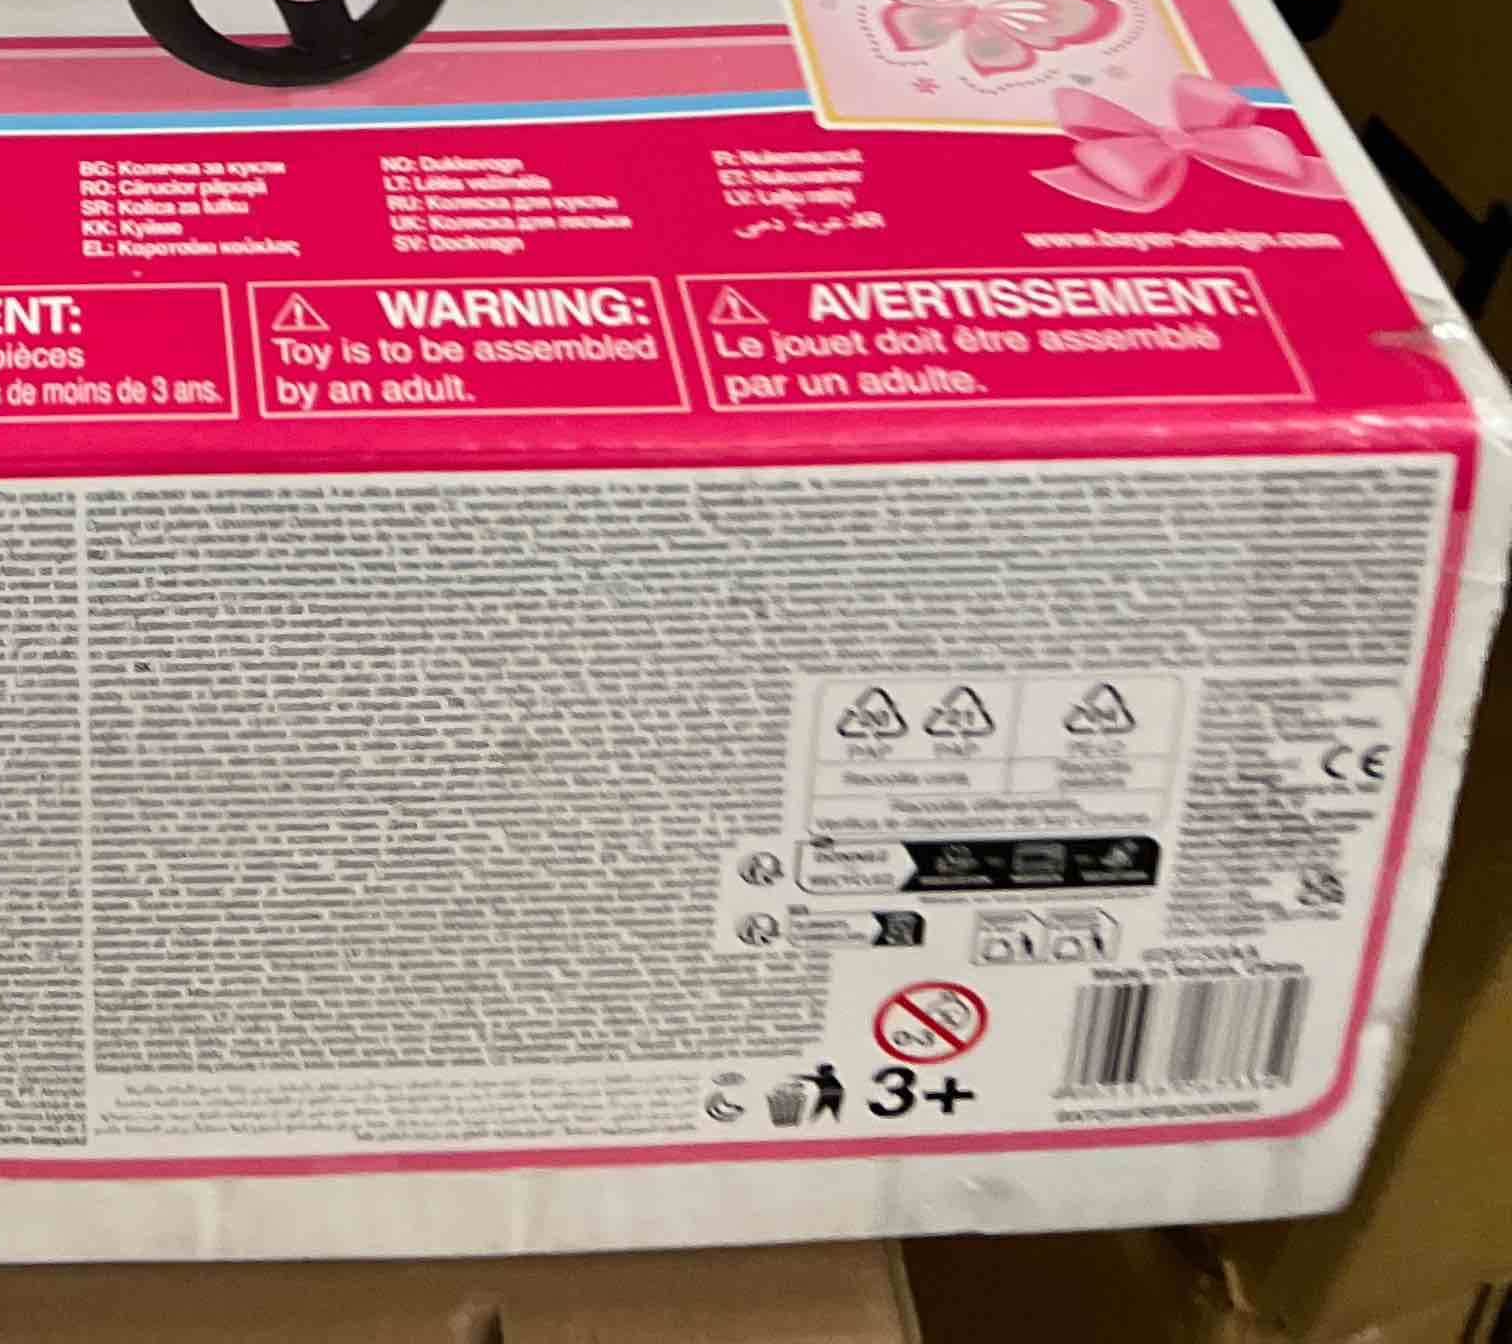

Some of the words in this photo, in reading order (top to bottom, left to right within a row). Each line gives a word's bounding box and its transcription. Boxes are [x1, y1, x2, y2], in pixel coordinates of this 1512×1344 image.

[376, 288, 651, 329] WARNING:
[808, 278, 1258, 322] AVERTISSEMENT:
[270, 336, 333, 370] Toy
[340, 337, 371, 364] is
[377, 337, 413, 364] to
[418, 335, 466, 364] be
[473, 333, 659, 362] assembled
[713, 330, 765, 359] Le
[769, 329, 869, 364] jouet
[874, 326, 949, 355] doit
[952, 324, 1031, 354] être
[1036, 322, 1221, 353] assemblé
[6, 378, 37, 406] de
[42, 377, 112, 404] moins
[116, 377, 146, 404] de
[151, 376, 168, 403] 3
[172, 380, 223, 404] ans.
[275, 376, 318, 411] by
[327, 378, 372, 404] an
[381, 375, 476, 403] adult.
[723, 373, 788, 405] par
[797, 372, 851, 399] un
[856, 366, 988, 397] adulte.
[867, 1066, 975, 1118] 3+
